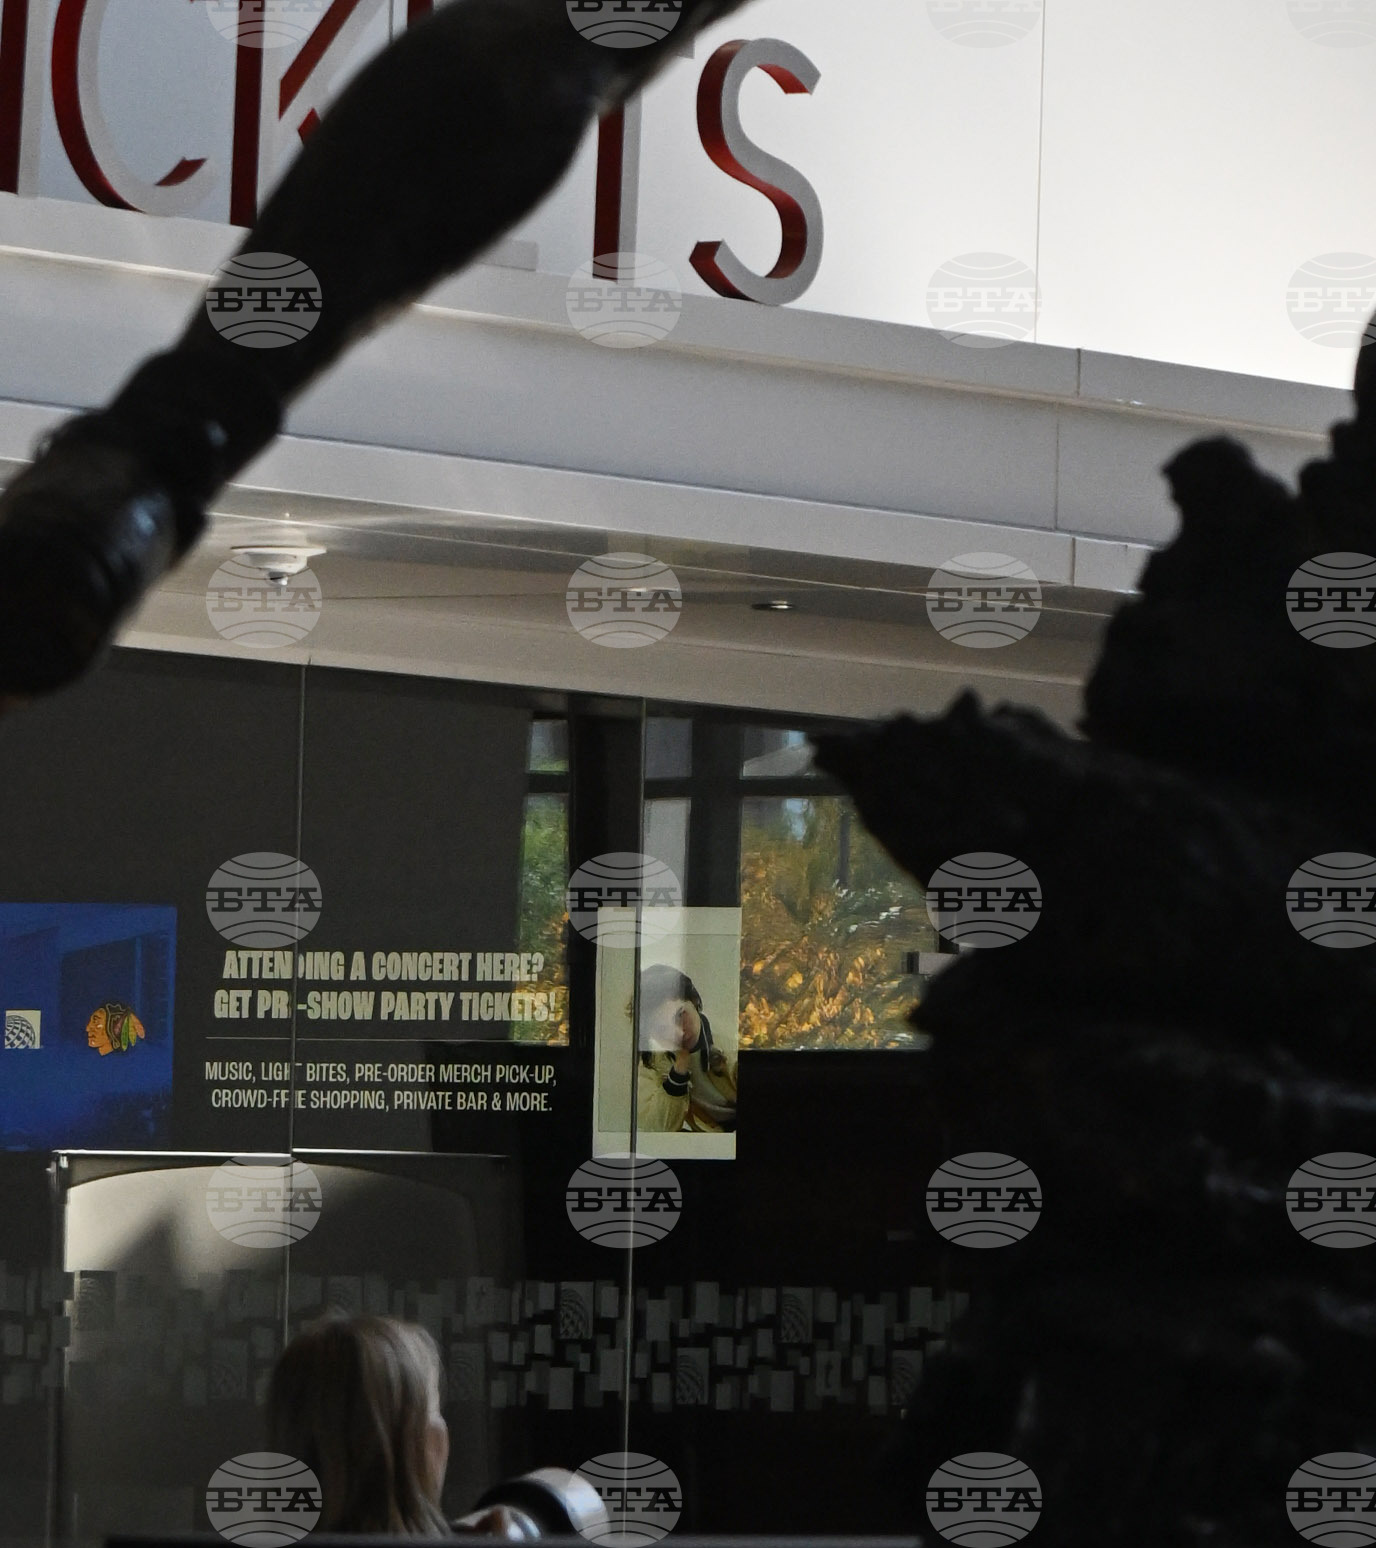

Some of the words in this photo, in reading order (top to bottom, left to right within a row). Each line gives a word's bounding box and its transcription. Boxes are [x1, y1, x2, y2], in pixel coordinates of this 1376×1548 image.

[350, 951, 367, 981] A
[372, 952, 472, 982] CONCERT
[476, 952, 545, 982] HERE?
[213, 989, 253, 1019] GET
[257, 990, 375, 1021] PR-SHOW
[380, 991, 455, 1021] PARTY
[459, 992, 556, 1022] TICKETS!
[205, 1061, 256, 1083] MUSIC,
[306, 1063, 350, 1084] BITES,
[355, 1063, 436, 1083] PRE-ORDER
[439, 1064, 492, 1083] MERCH
[495, 1064, 557, 1087] PICK-UP,
[310, 1090, 390, 1113] SHOPPING,
[394, 1090, 453, 1110] PRIVATE
[456, 1091, 488, 1111] BAR
[491, 1092, 502, 1111] &
[506, 1092, 553, 1112] MORE.
